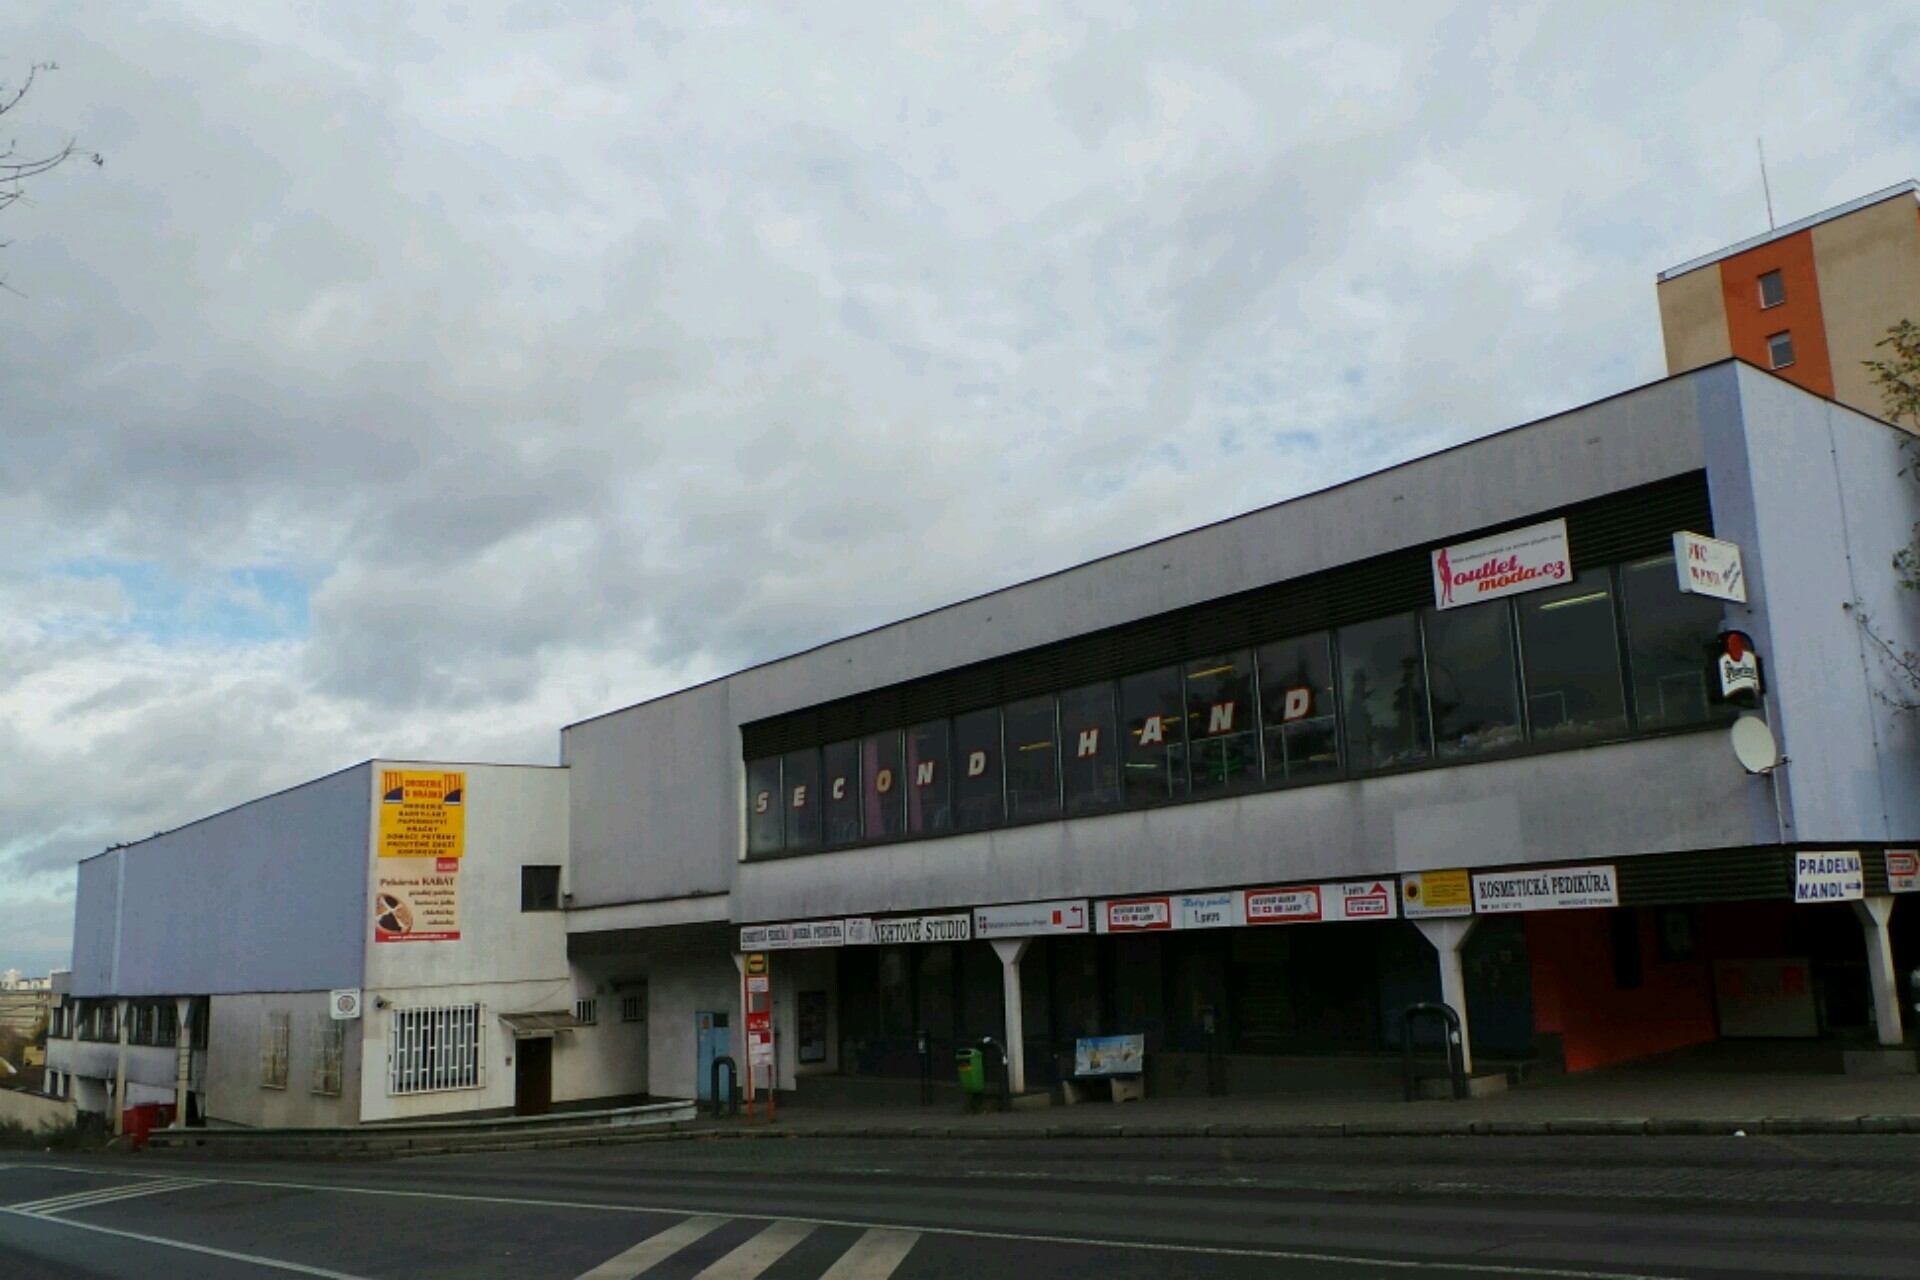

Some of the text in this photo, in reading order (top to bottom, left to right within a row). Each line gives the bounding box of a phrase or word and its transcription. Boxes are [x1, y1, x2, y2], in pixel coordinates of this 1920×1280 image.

[1453, 553, 1518, 586] outlet
[1477, 559, 1566, 593] moda.cz
[754, 686, 1313, 815] SECOND HAND
[1798, 853, 1861, 875] PRÁDELNA
[422, 875, 455, 886] KABÁT
[1479, 873, 1549, 899] KOSMETICKÁ
[1550, 870, 1611, 896] PEDIKÚRA
[1797, 881, 1845, 900] MANDL
[872, 918, 922, 943] NEHTOVÉ
[925, 919, 968, 941] STUDIO
